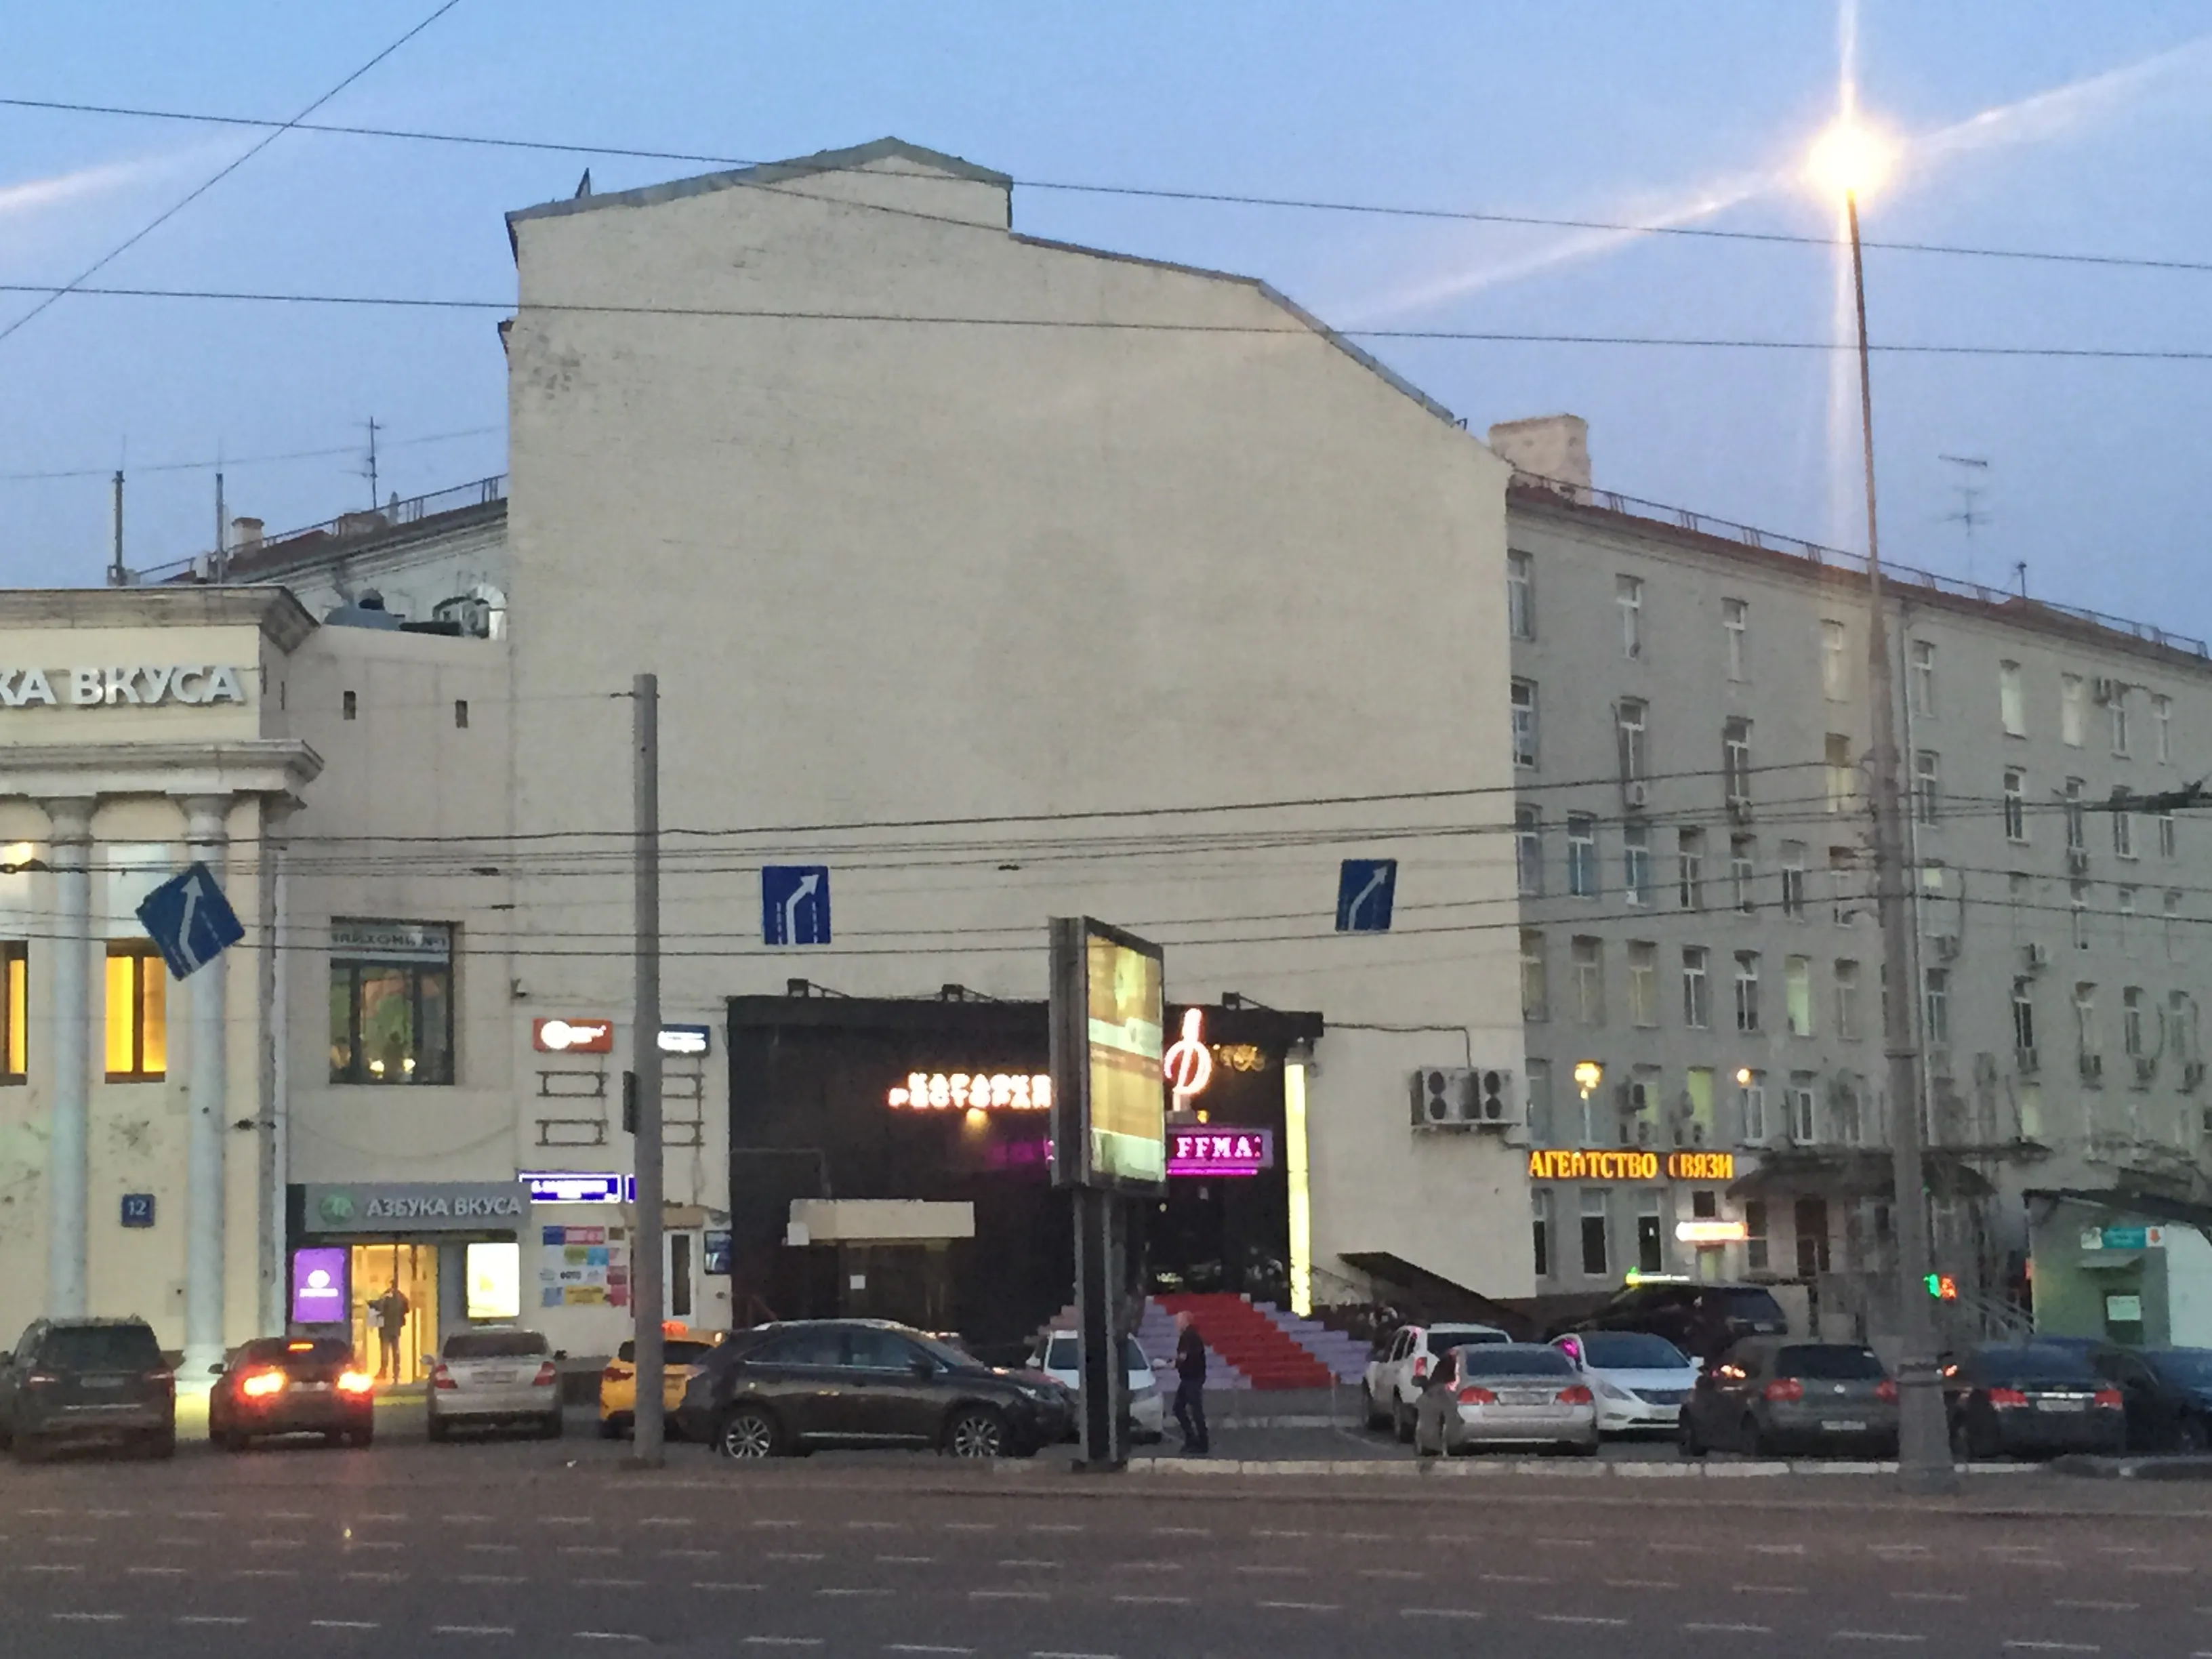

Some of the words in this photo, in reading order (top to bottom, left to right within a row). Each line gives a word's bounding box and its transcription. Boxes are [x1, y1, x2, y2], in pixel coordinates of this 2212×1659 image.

[70, 665, 243, 705] ВКУСА
[1529, 1150, 1658, 1179] АГЕНТСТВО
[128, 1200, 147, 1216] 12
[367, 1197, 449, 1217] АЗБУКА
[454, 1196, 522, 1215] ВКУСА
